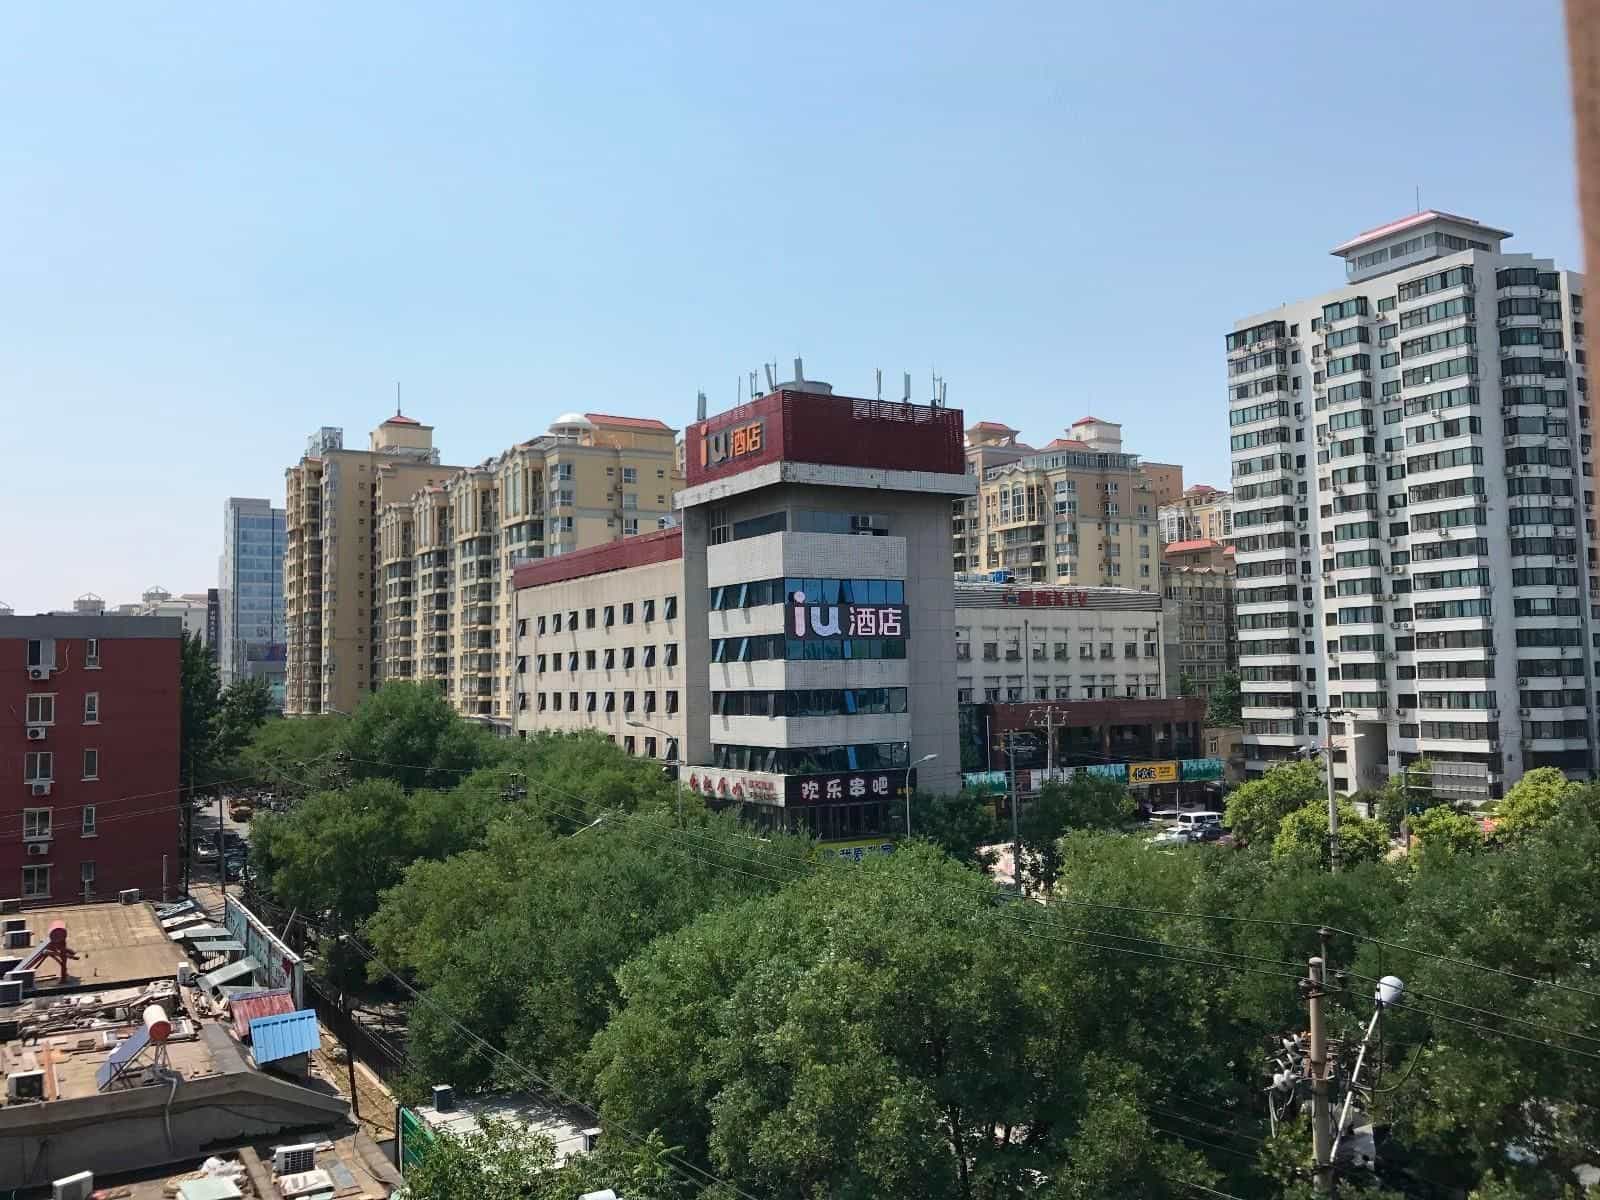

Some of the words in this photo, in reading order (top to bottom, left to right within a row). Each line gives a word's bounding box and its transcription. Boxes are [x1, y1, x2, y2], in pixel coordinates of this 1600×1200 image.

[794, 591, 902, 636] iu酒店
[801, 776, 888, 800] 欢乐串吧
